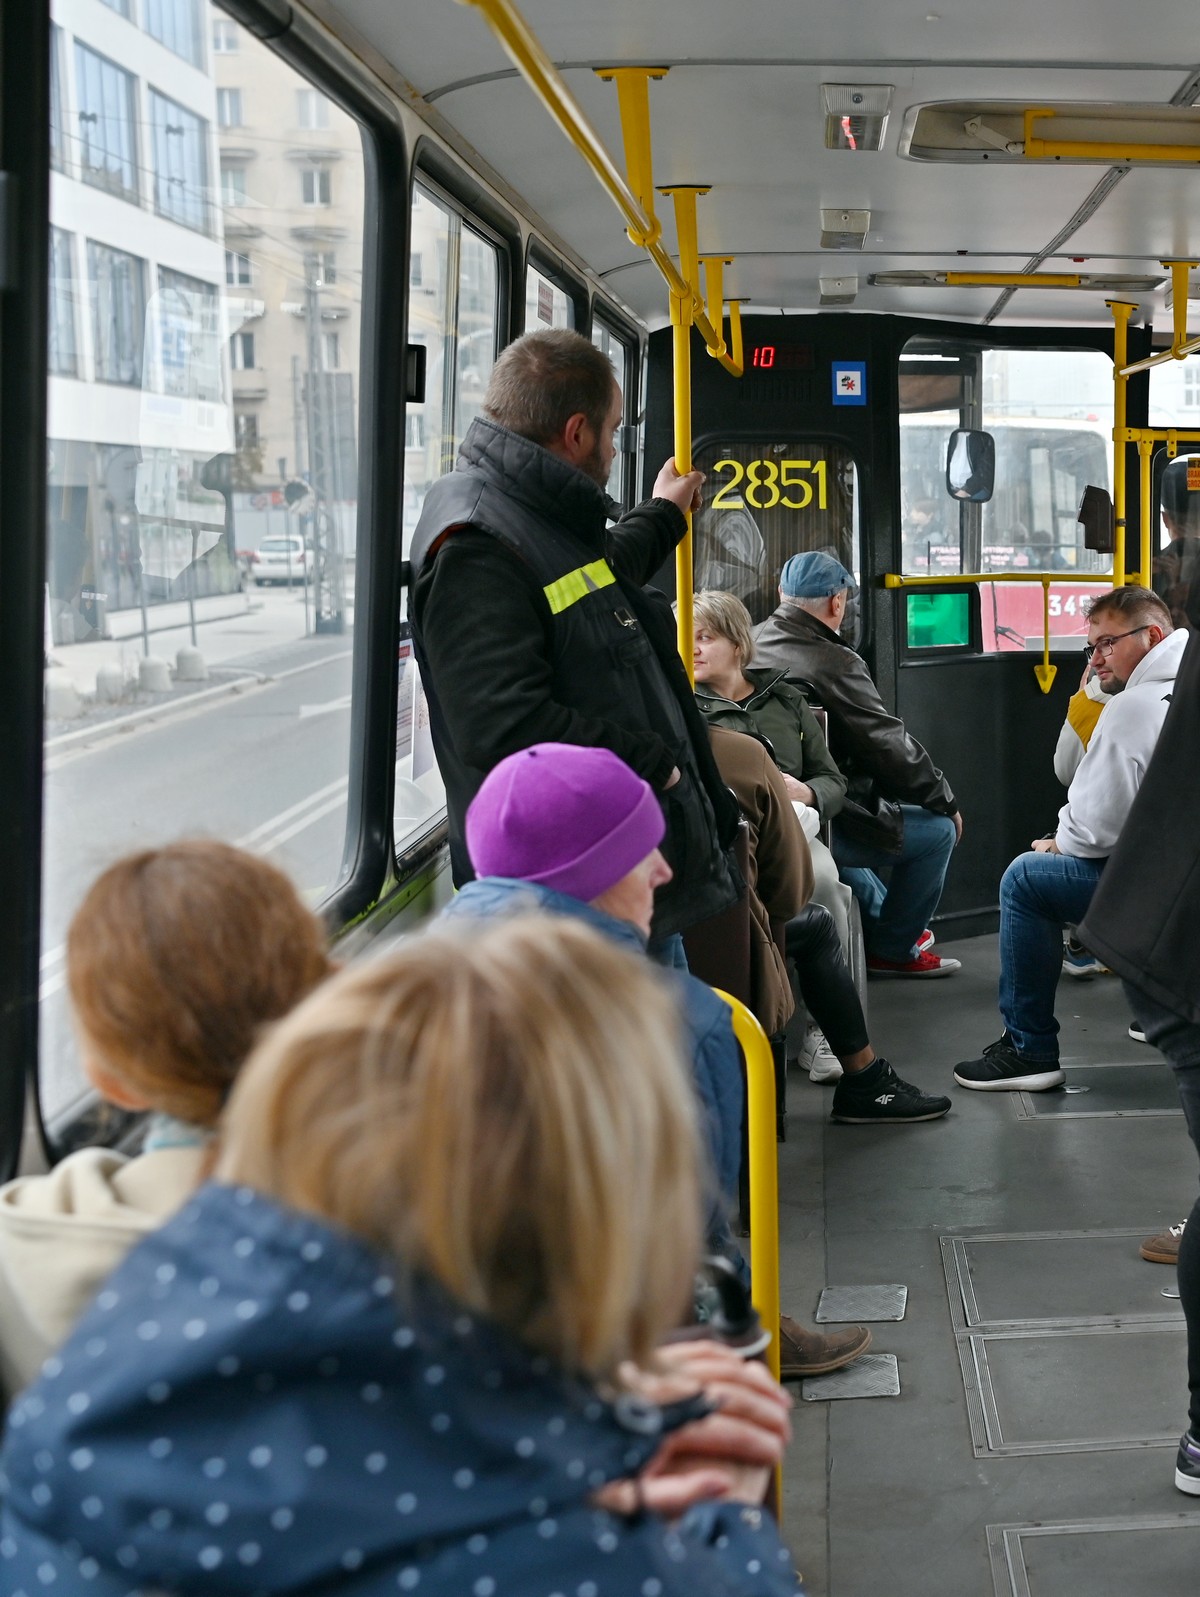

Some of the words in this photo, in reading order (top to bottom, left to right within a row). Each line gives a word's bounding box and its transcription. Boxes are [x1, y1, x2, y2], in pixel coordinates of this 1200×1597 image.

[753, 346, 776, 368] 10
[711, 459, 827, 510] 2851
[874, 1093, 896, 1105] 4F
